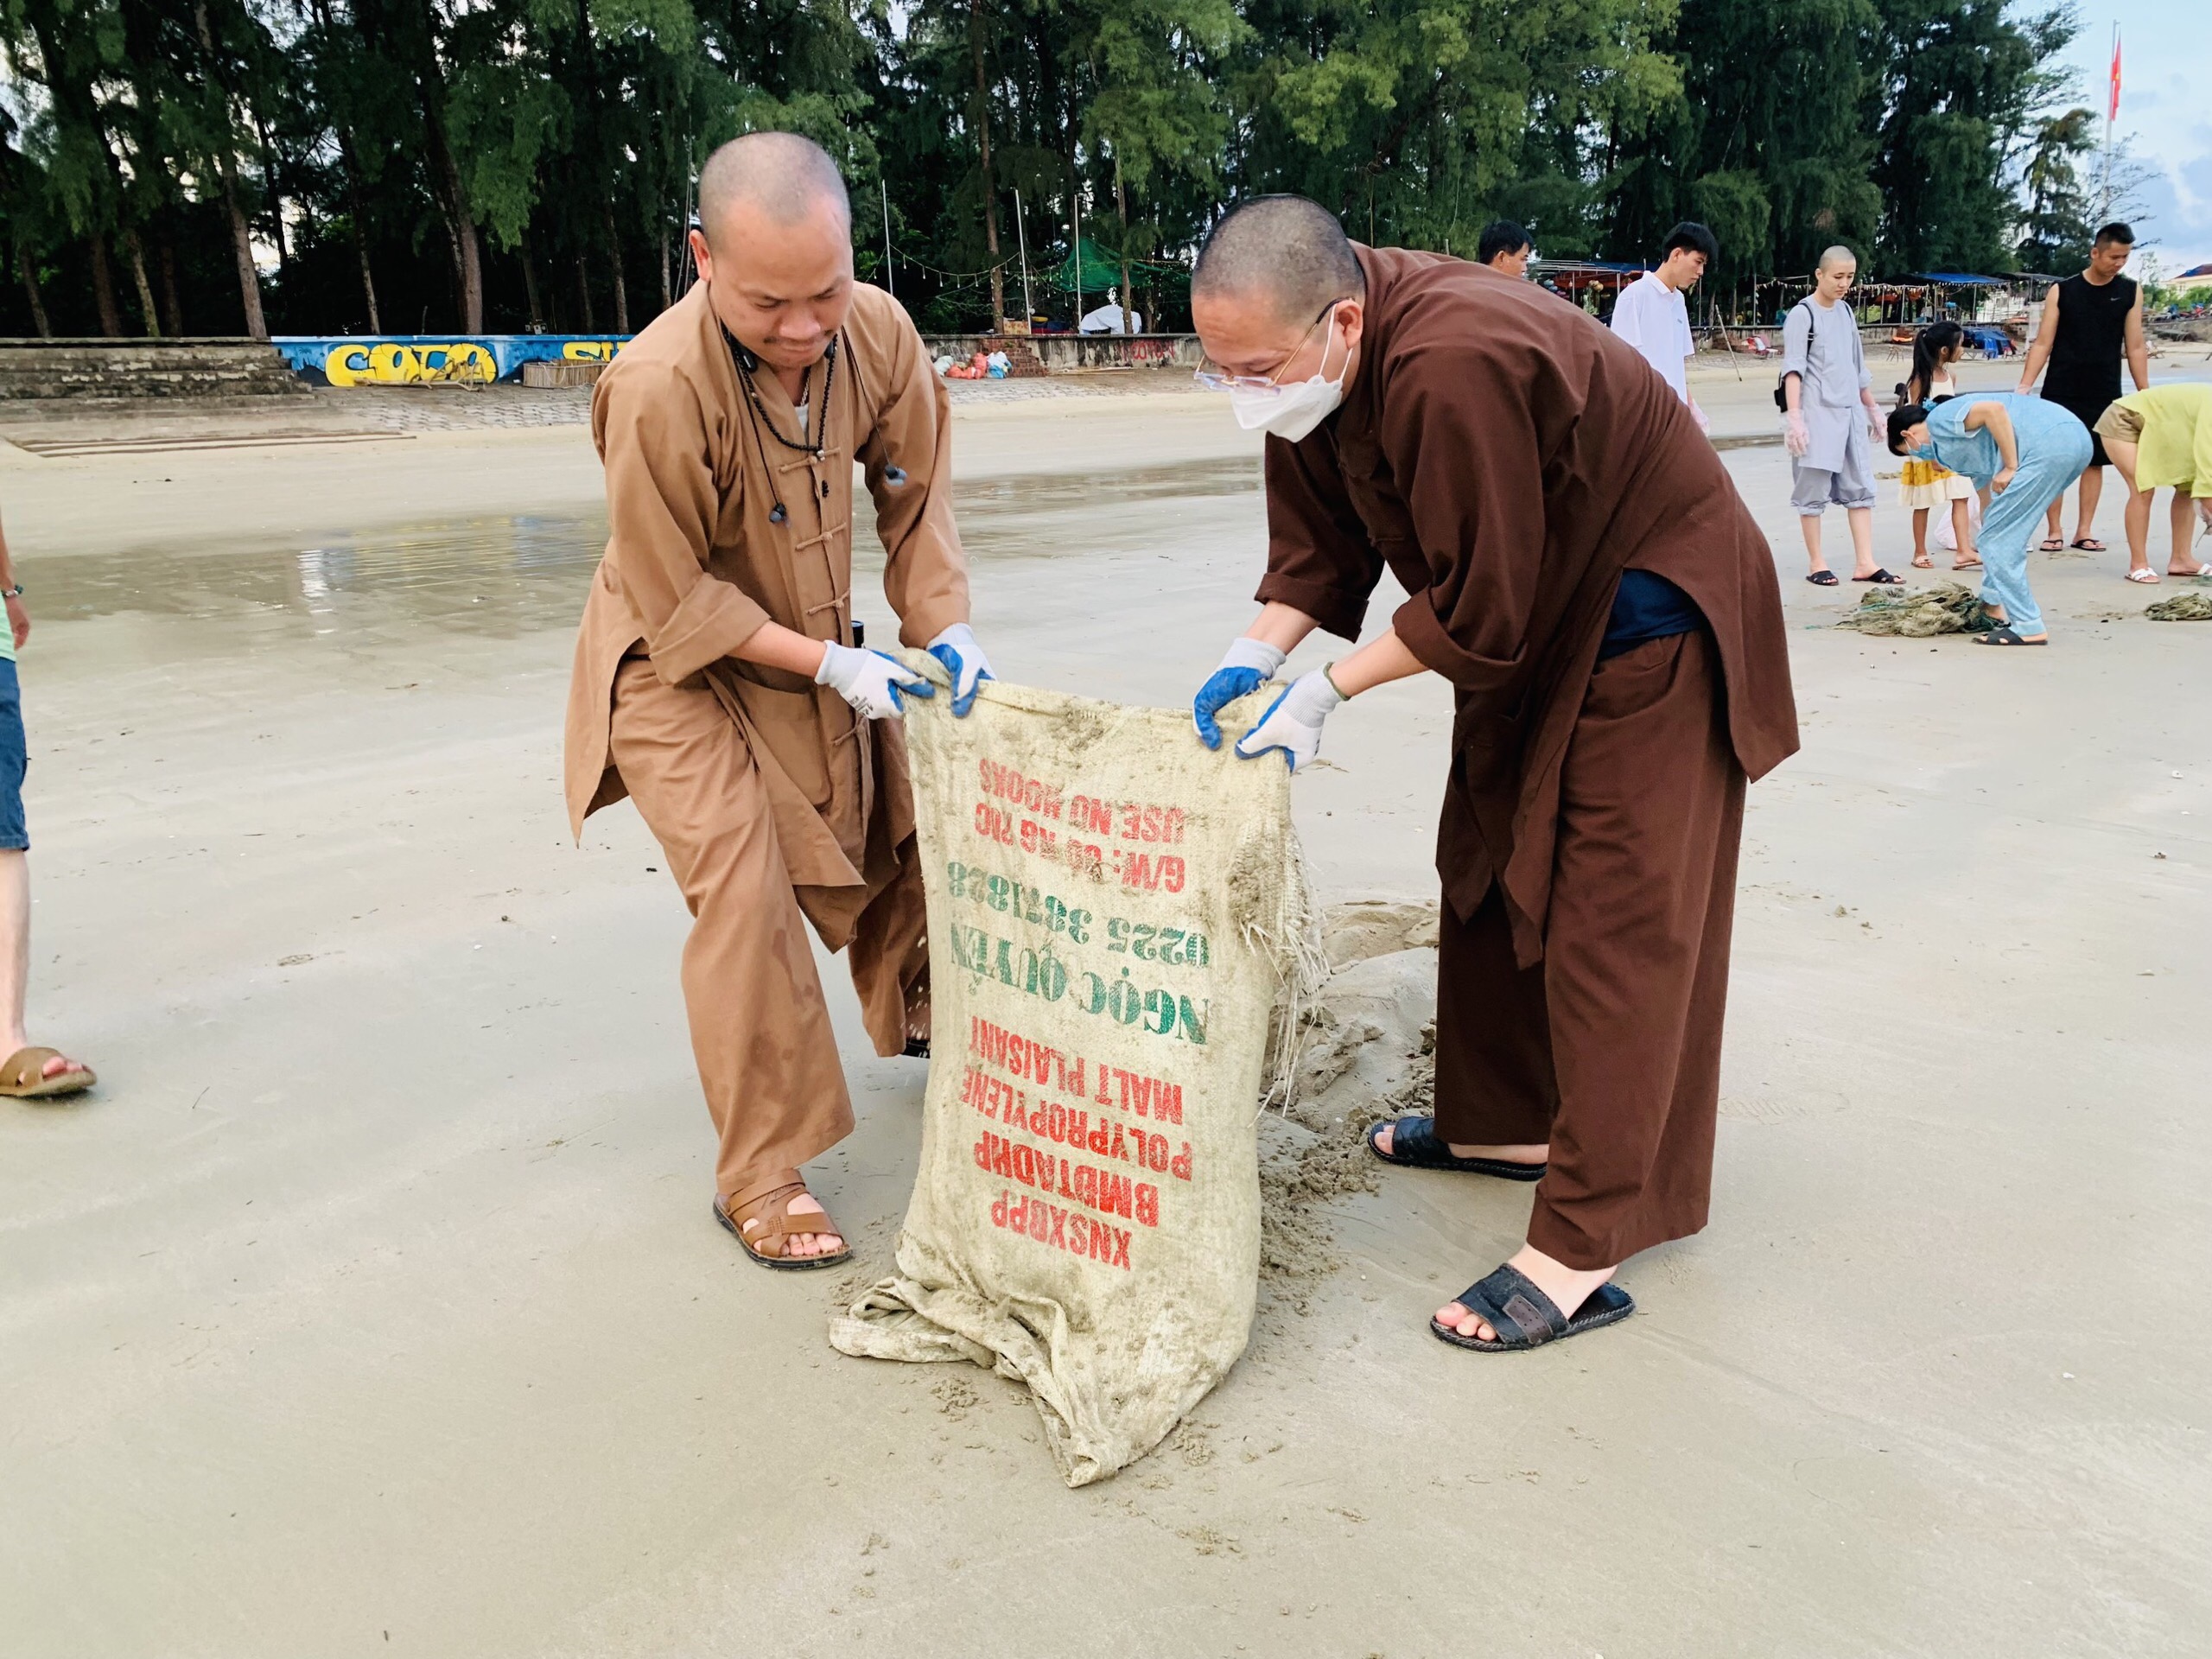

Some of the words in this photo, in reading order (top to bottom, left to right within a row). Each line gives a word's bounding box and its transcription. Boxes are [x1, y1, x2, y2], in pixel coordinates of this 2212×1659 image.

[325, 343, 499, 388] COTO
[979, 758, 1063, 821] HOOKS
[1069, 795, 1111, 836] NO
[1122, 804, 1186, 846] USE
[1107, 917, 1209, 968] 0225
[1079, 966, 1209, 1045] NGỌC
[969, 1015, 1085, 1097] PLAISANT
[960, 1065, 1193, 1181] POLYPROPYLENE
[1095, 1064, 1183, 1126] MALT
